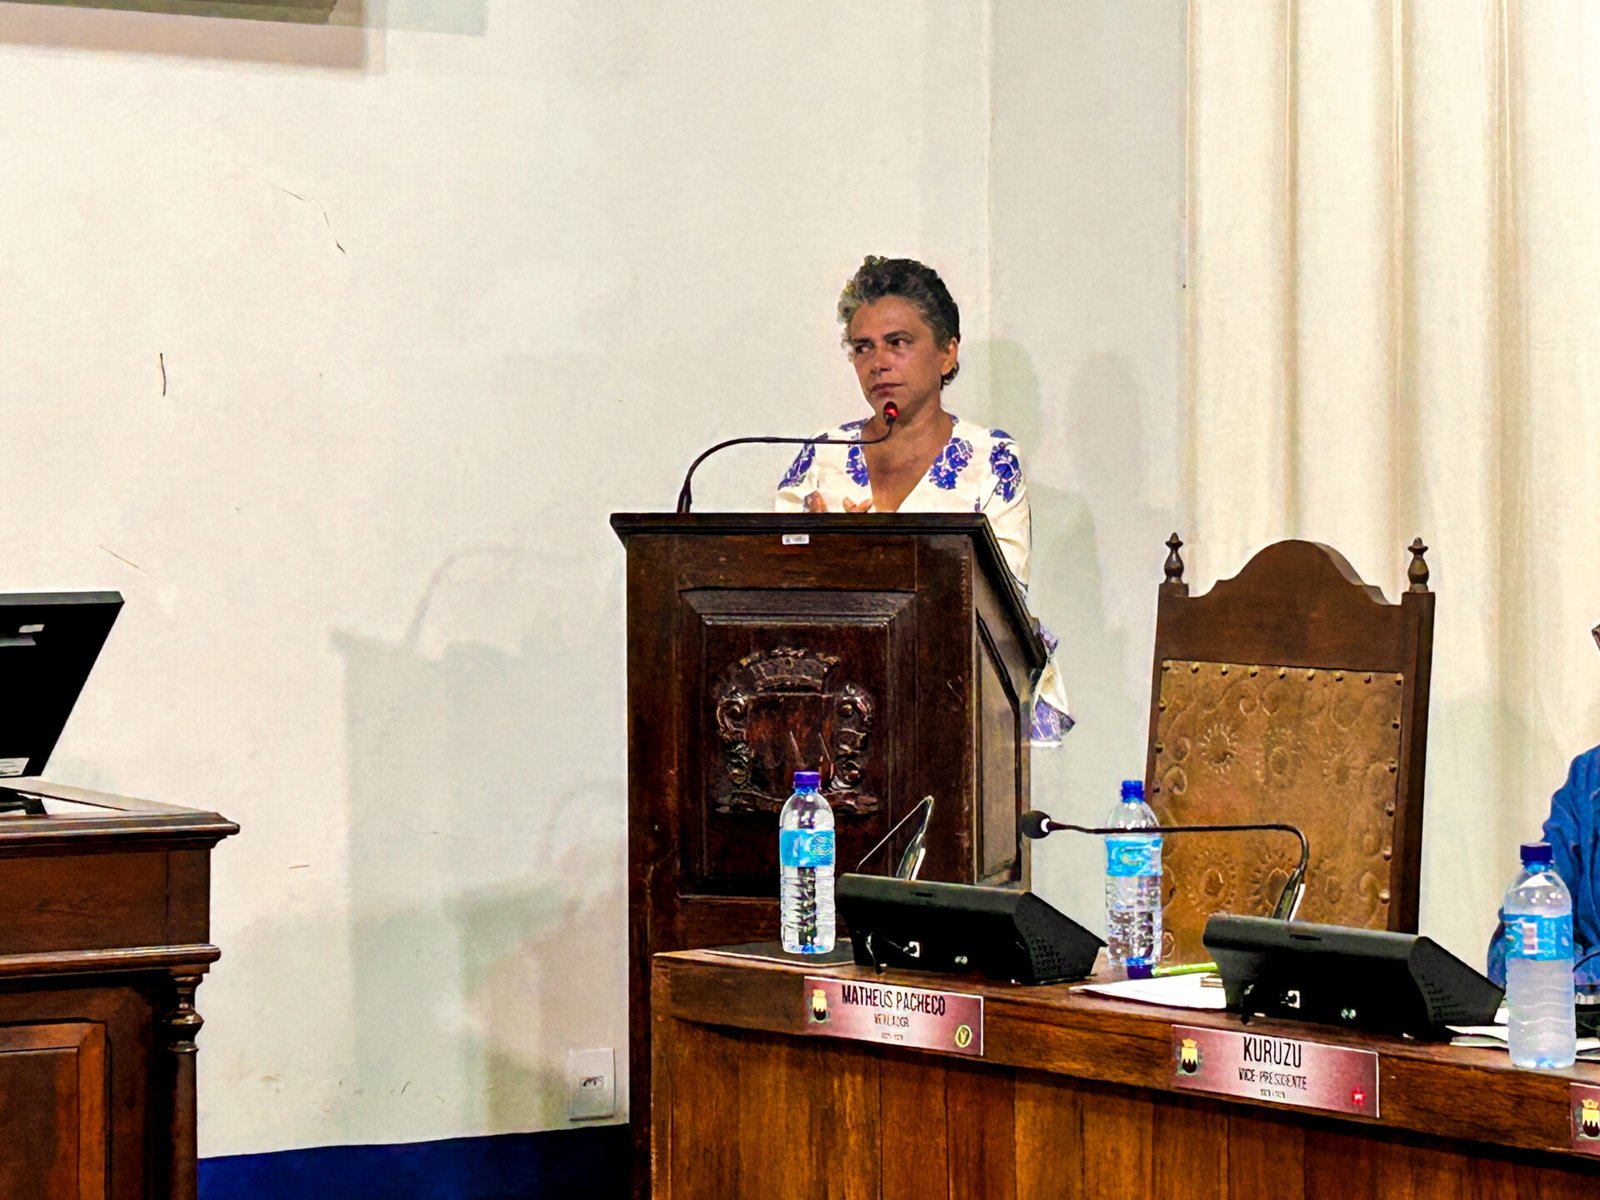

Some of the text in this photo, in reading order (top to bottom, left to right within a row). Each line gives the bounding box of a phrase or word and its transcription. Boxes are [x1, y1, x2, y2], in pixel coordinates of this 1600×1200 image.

[841, 984, 946, 1017] MATHEUS PACHECO
[1243, 1036, 1302, 1068] KURUZU
